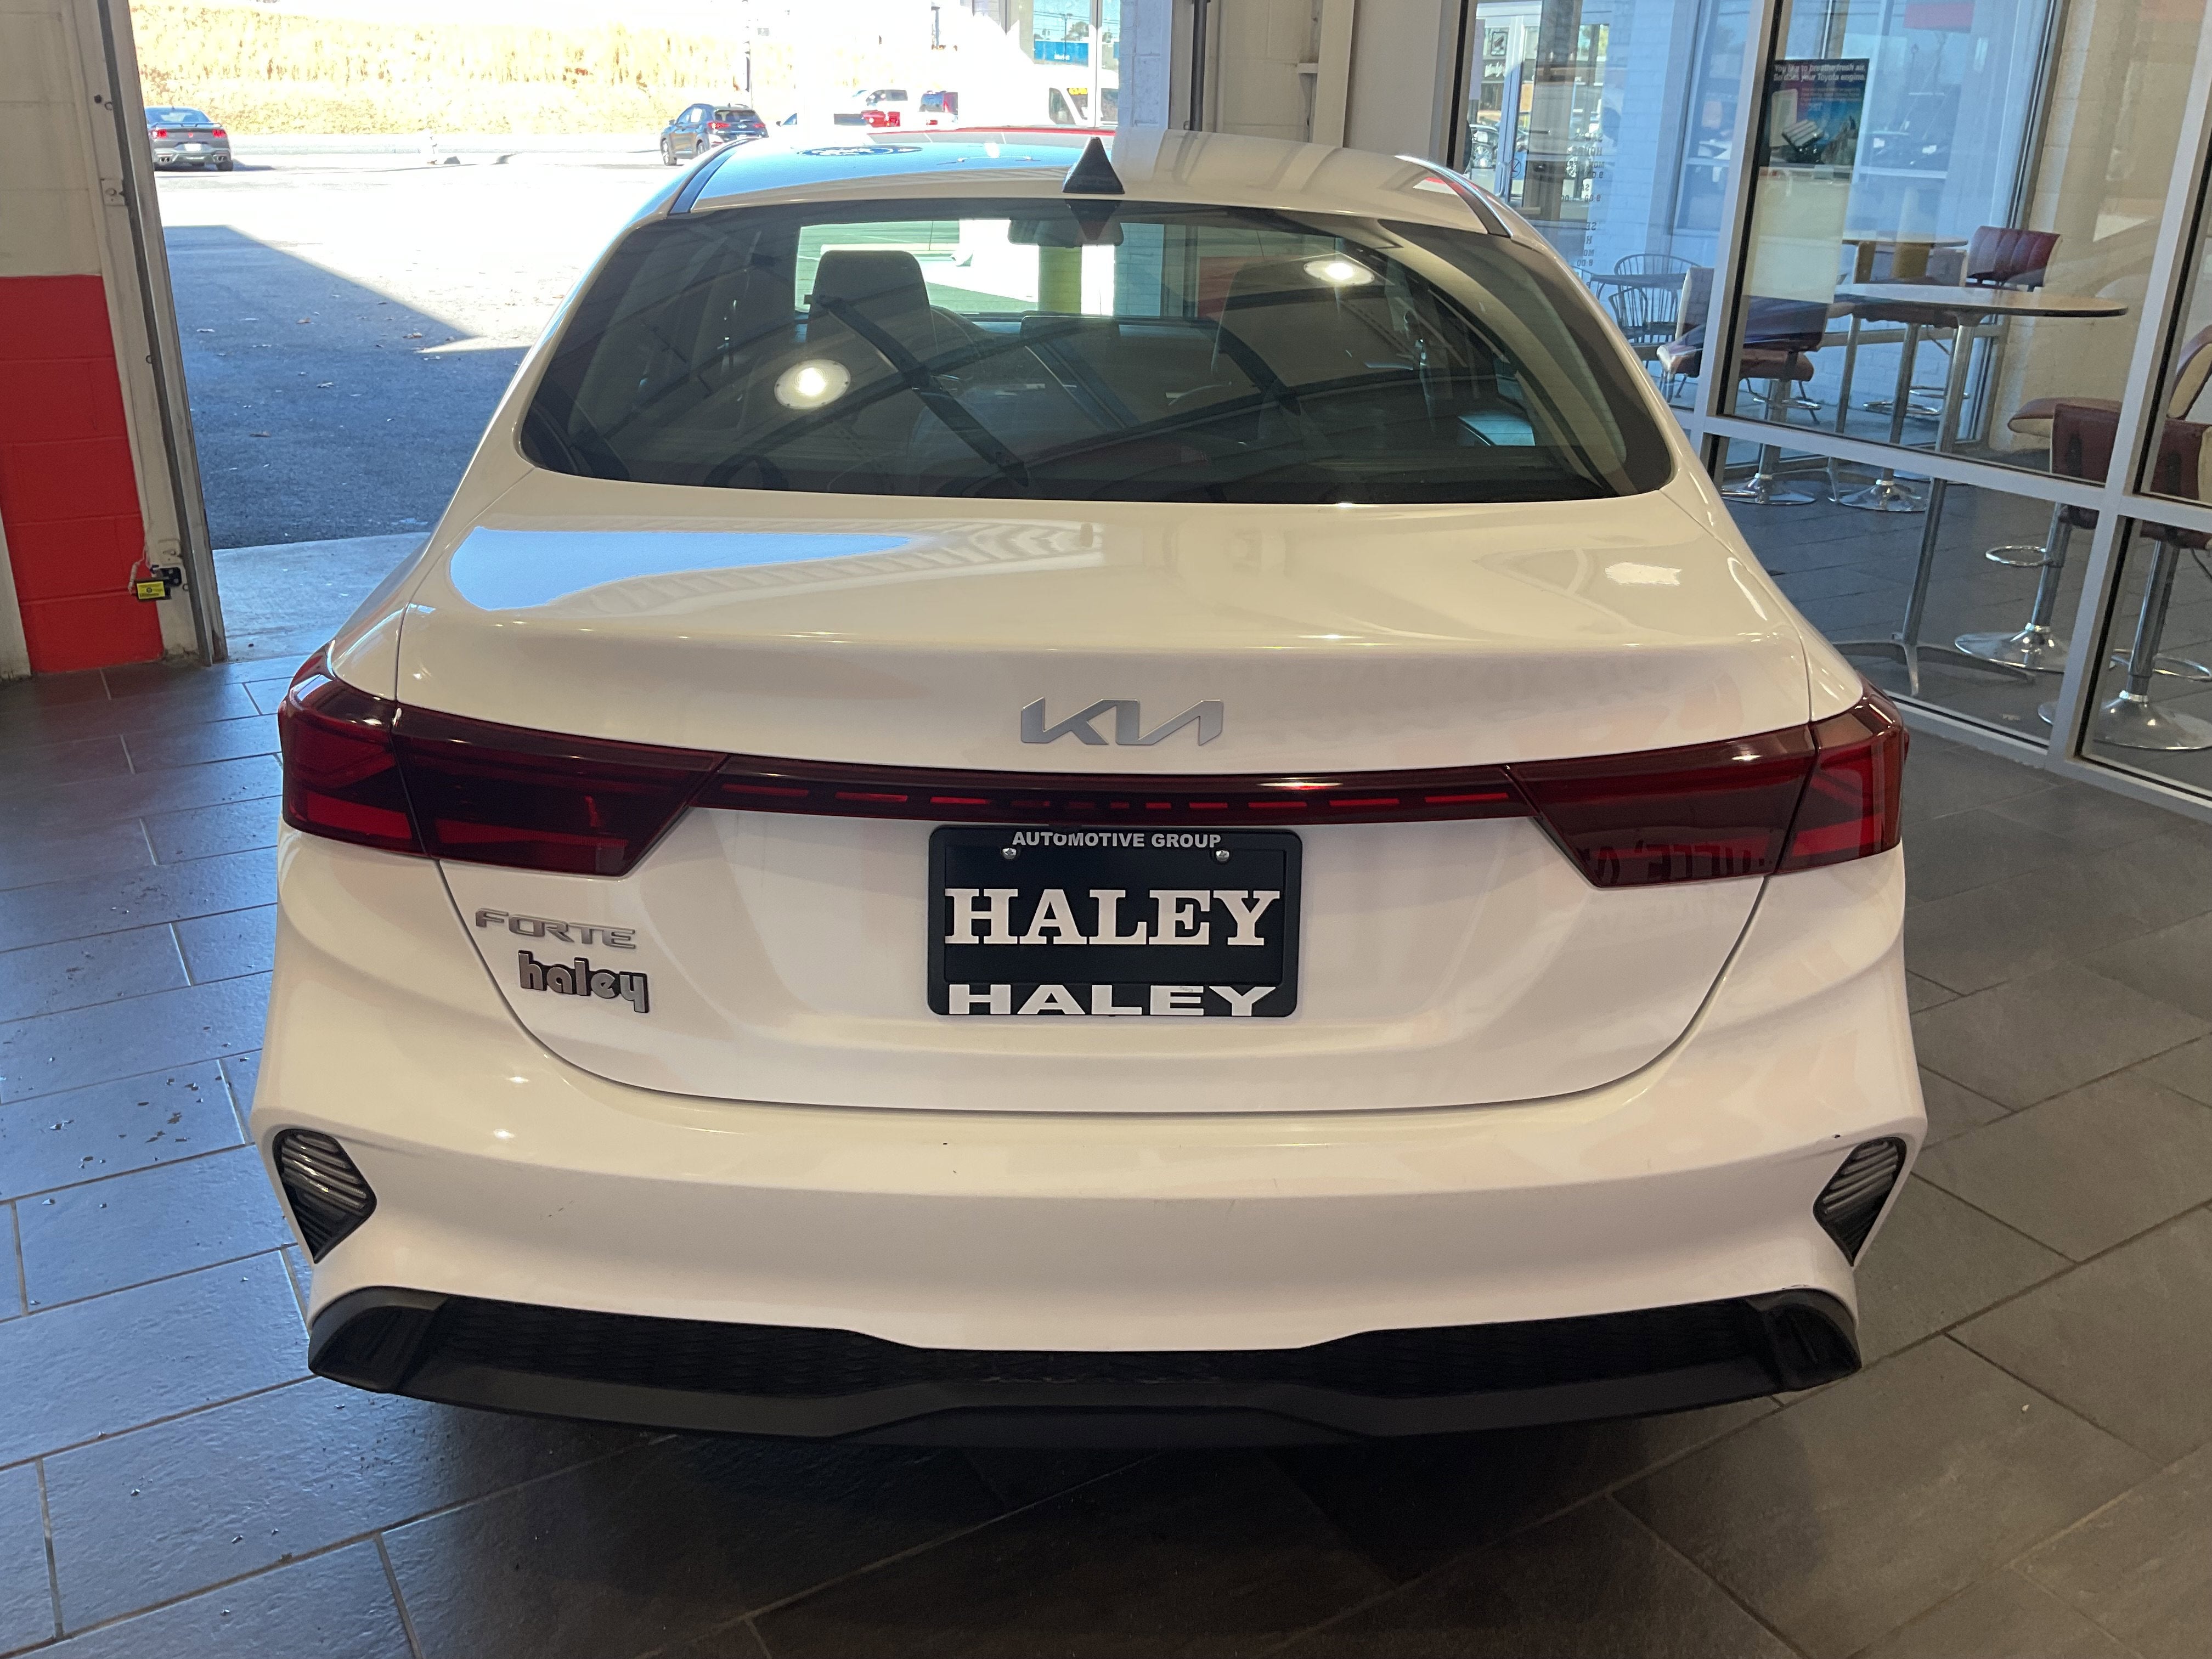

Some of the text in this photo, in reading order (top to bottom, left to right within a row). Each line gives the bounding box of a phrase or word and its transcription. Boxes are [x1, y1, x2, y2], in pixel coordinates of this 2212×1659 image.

[1801, 74, 1816, 82] your
[1817, 72, 1839, 82] Toyota
[1012, 831, 1222, 849] AUTOMOTIVE GROUP
[475, 908, 636, 950] FORTE
[944, 888, 1280, 946] HALEY
[517, 950, 650, 1013] haley
[949, 984, 1277, 1017] HALEY
